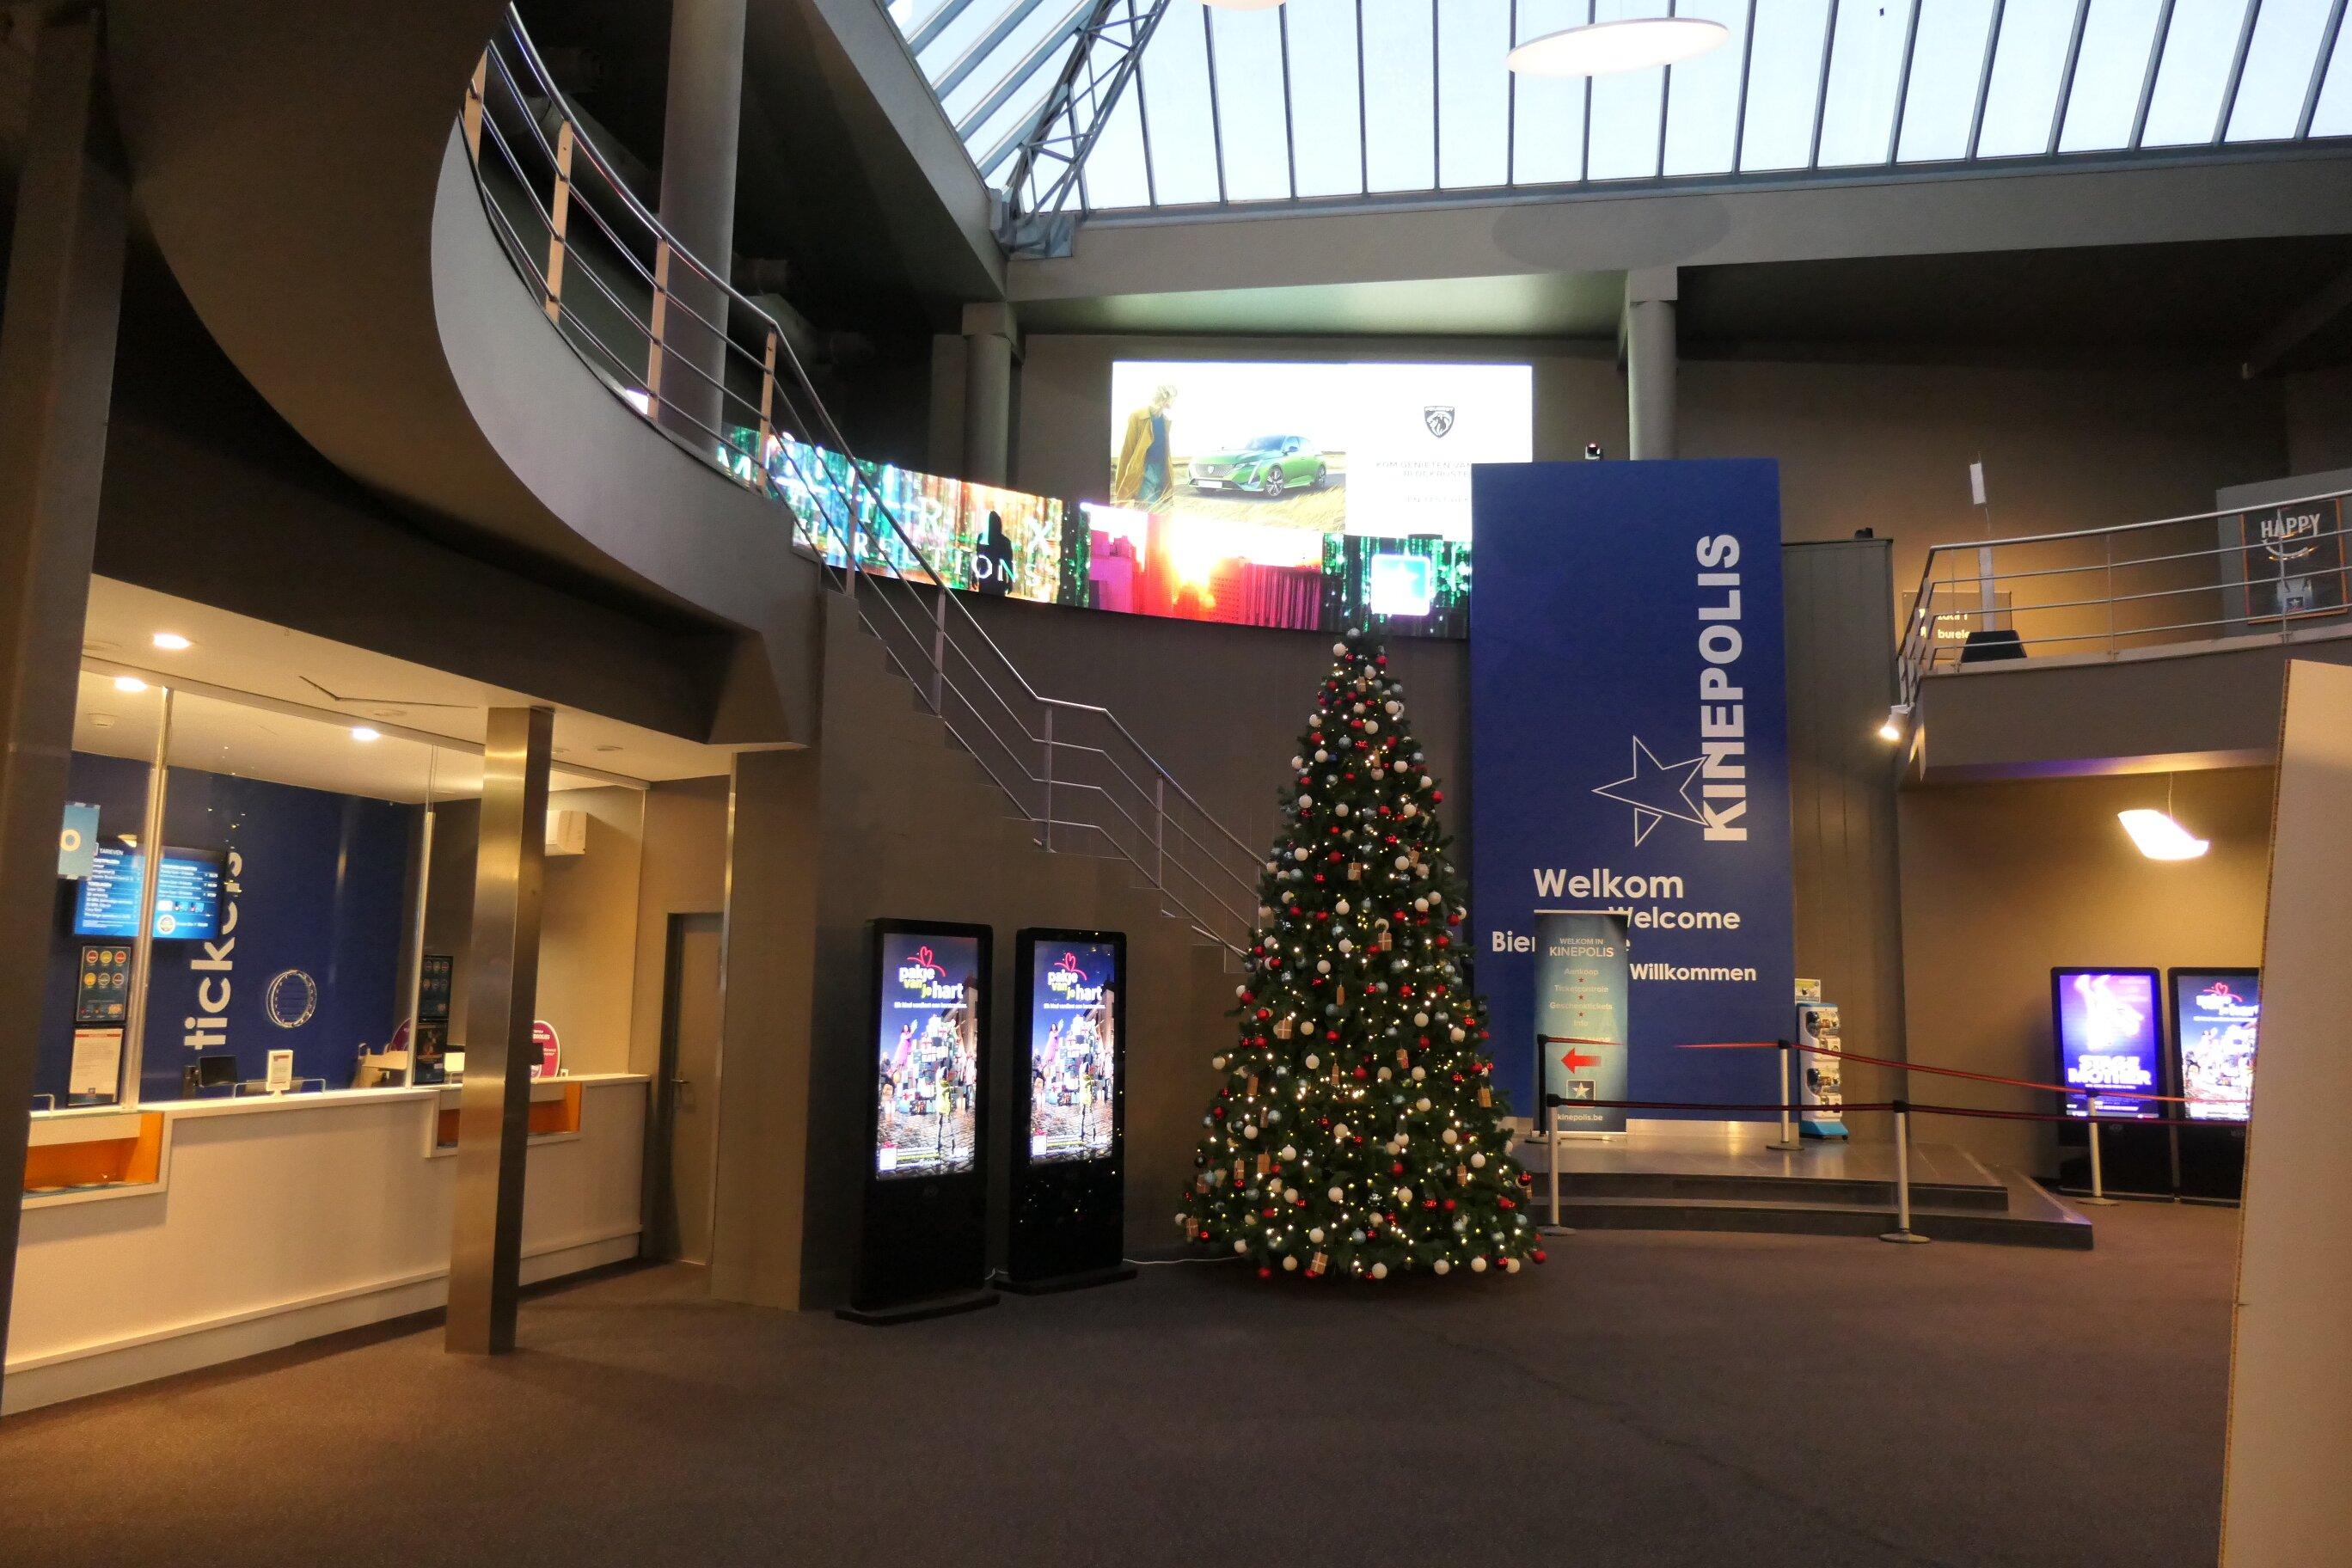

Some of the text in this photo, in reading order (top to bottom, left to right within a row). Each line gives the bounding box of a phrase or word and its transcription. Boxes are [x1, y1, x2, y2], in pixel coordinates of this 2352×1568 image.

[2260, 513, 2321, 539] HAPPY
[1696, 533, 1749, 842] KINEPOLIS
[1534, 868, 1684, 898] Welkom
[1549, 946, 1614, 958] KINEPOLIS
[1564, 967, 1599, 977] Aankoop
[1630, 963, 1757, 981] Willkommen
[933, 981, 964, 999] hart
[1075, 983, 1102, 1001] hart
[1554, 984, 1609, 993] Ticketcontrole
[1549, 1001, 1613, 1010] Geschenktickets
[2067, 1068, 2152, 1085] MOTHER
[1557, 1113, 1603, 1122] kinepolis.be
